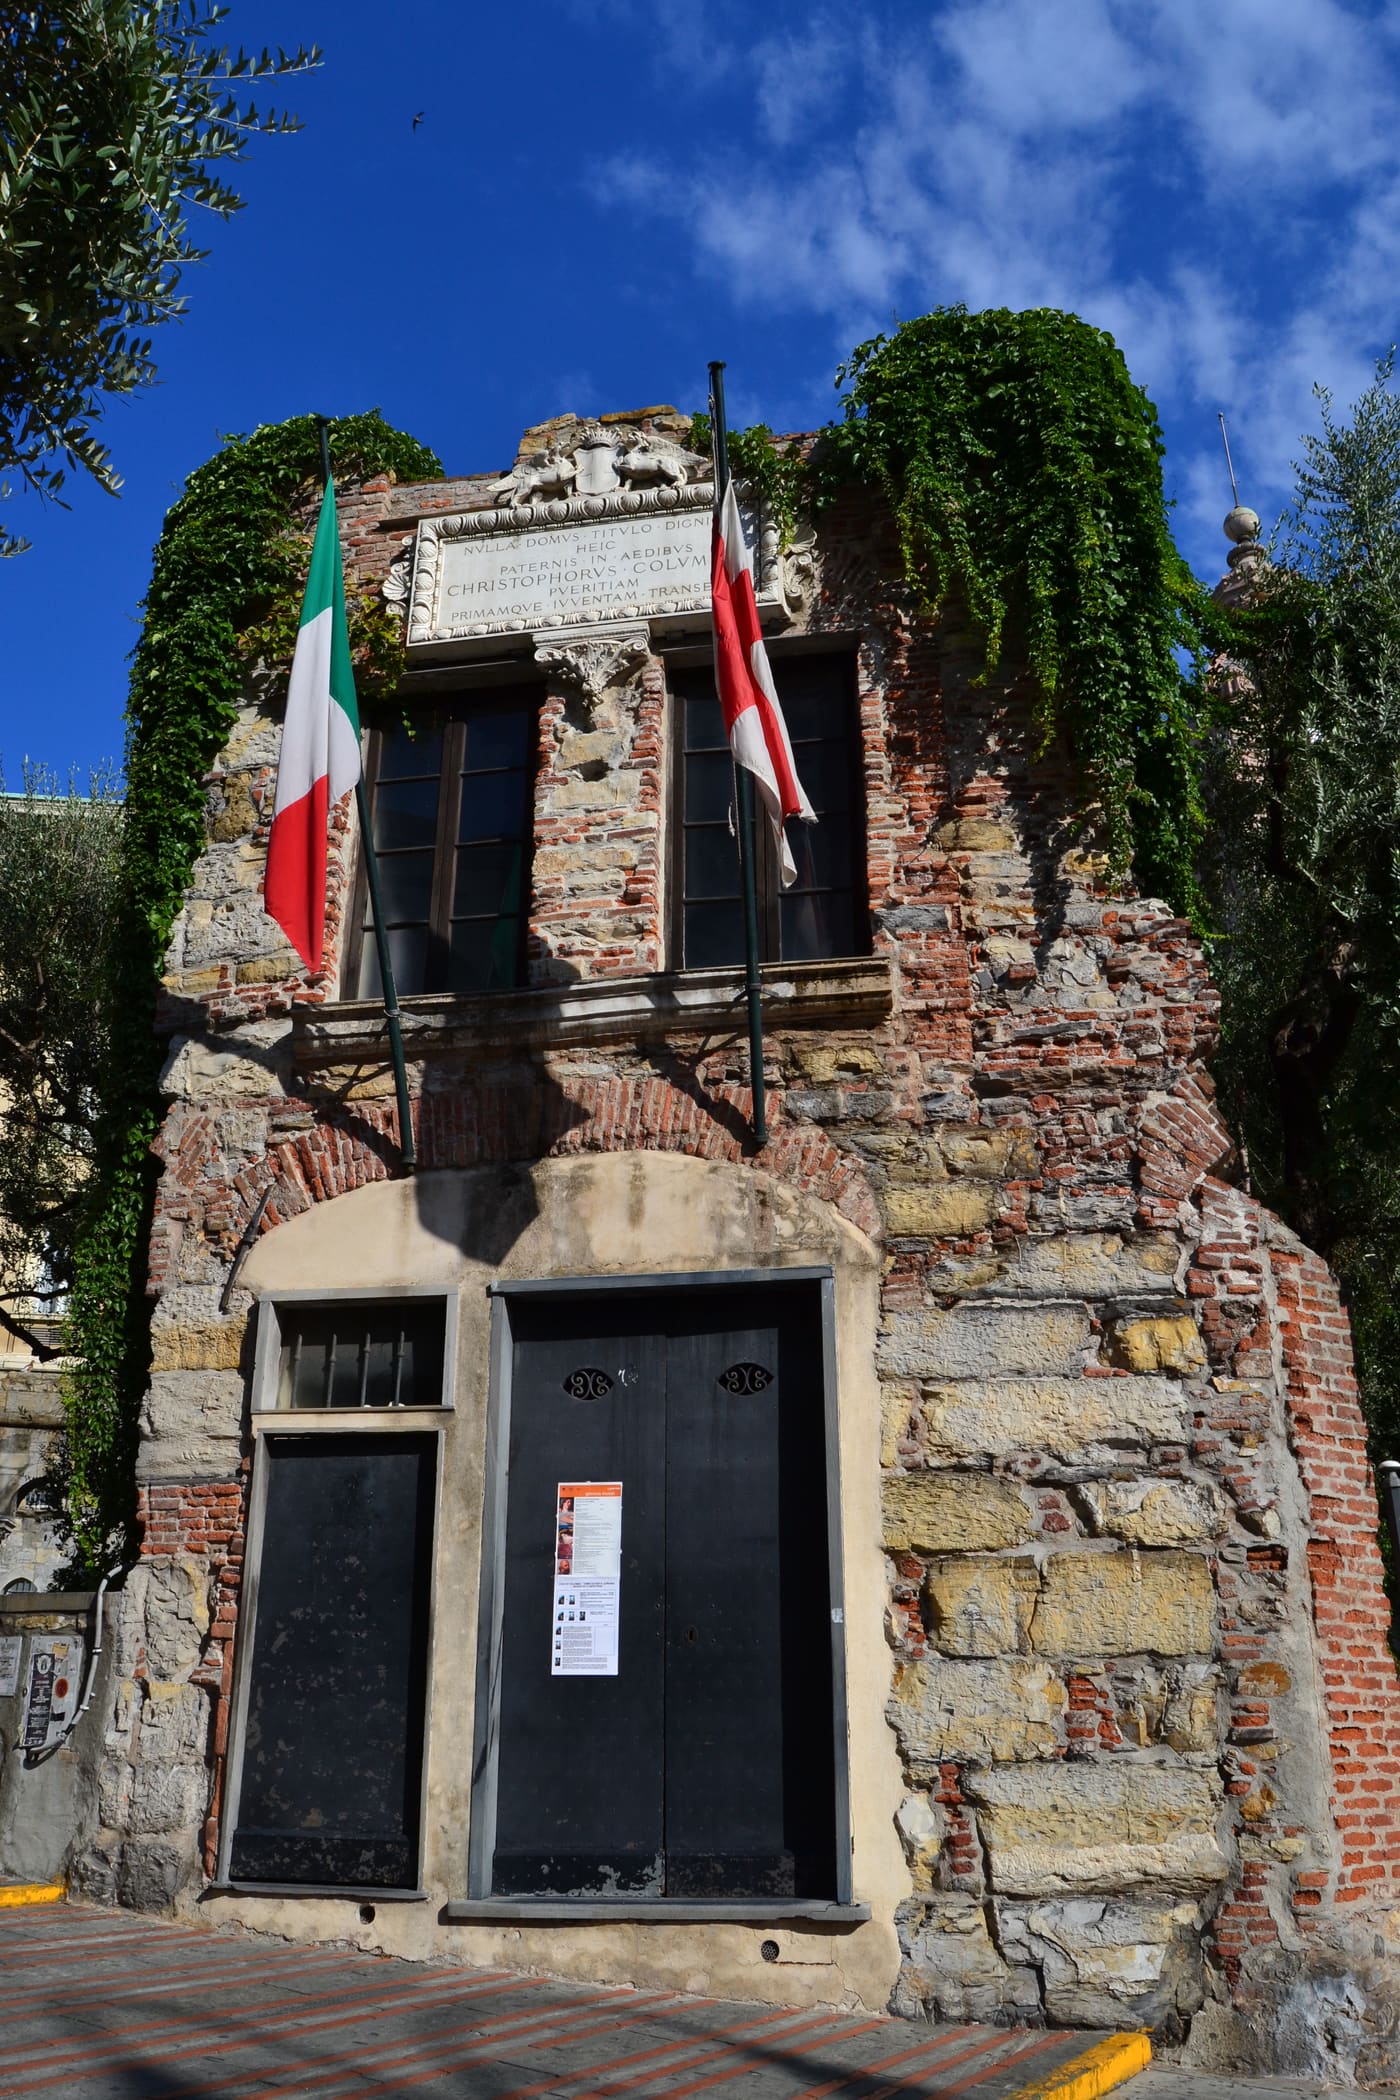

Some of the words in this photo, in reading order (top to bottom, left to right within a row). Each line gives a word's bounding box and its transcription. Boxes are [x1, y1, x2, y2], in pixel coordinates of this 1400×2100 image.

[464, 541, 516, 555] NVLLA
[526, 533, 580, 549] DOMVS
[592, 524, 652, 539] TITVLO
[665, 517, 710, 531] DIGNI
[576, 541, 616, 553] HEIC
[500, 558, 577, 575] PATERNIS
[592, 554, 607, 564] IN
[620, 544, 693, 560] AEDIBVS
[447, 565, 617, 597] CHRISTOPHORVS
[633, 555, 707, 573] COLVM
[550, 578, 639, 597] PVERITIAM
[451, 602, 543, 622] PRIMAMQVE
[553, 591, 637, 609] IVVENTAM
